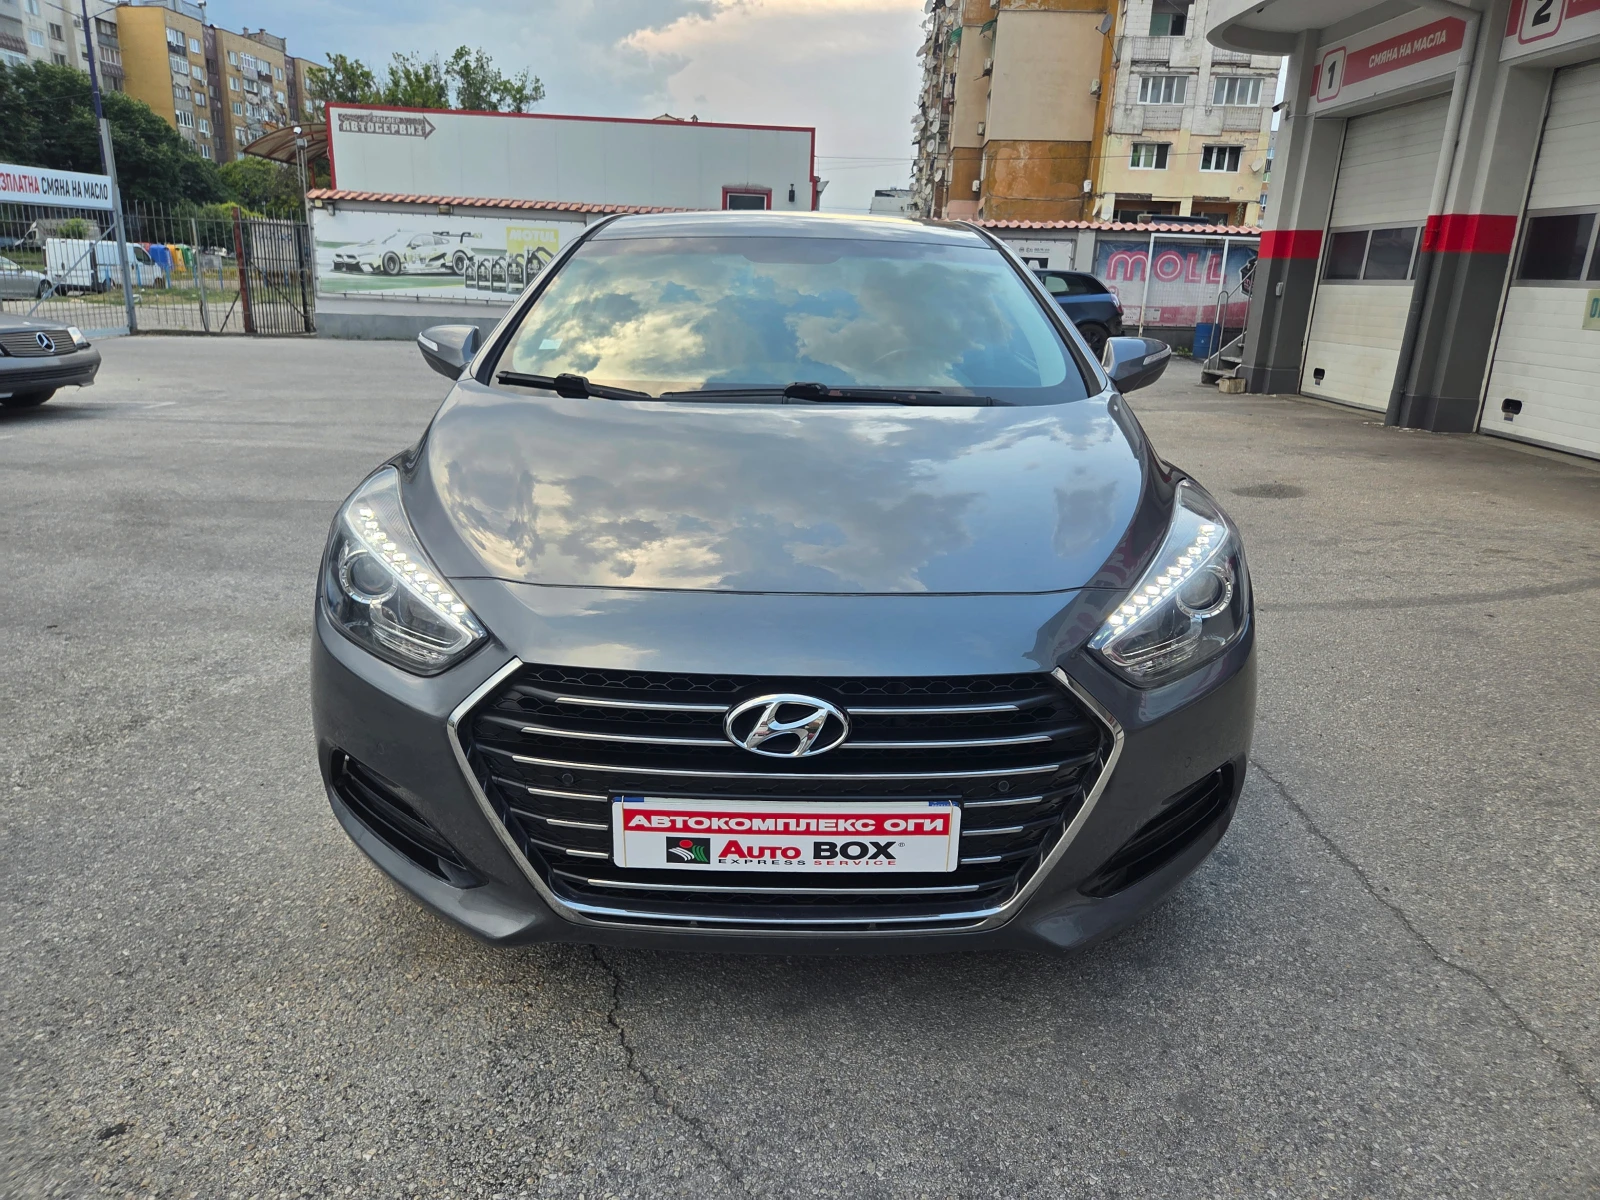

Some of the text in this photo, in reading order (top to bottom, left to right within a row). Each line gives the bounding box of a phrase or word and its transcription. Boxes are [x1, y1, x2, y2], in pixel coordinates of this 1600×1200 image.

[1368, 29, 1447, 68] СМЯНА НА МАСЛА
[1327, 61, 1337, 90] 1
[342, 120, 423, 136] АВТОСЕРВИЗ
[41, 176, 71, 197] СМЯНА
[71, 180, 83, 199] НА
[83, 181, 108, 200] МАСЛО
[509, 229, 556, 242] MOTUL
[1105, 250, 1227, 285] MOLL
[627, 814, 944, 832] АВТОКОМПЛЕКС ОГИ
[718, 858, 806, 866] EXPRESS
